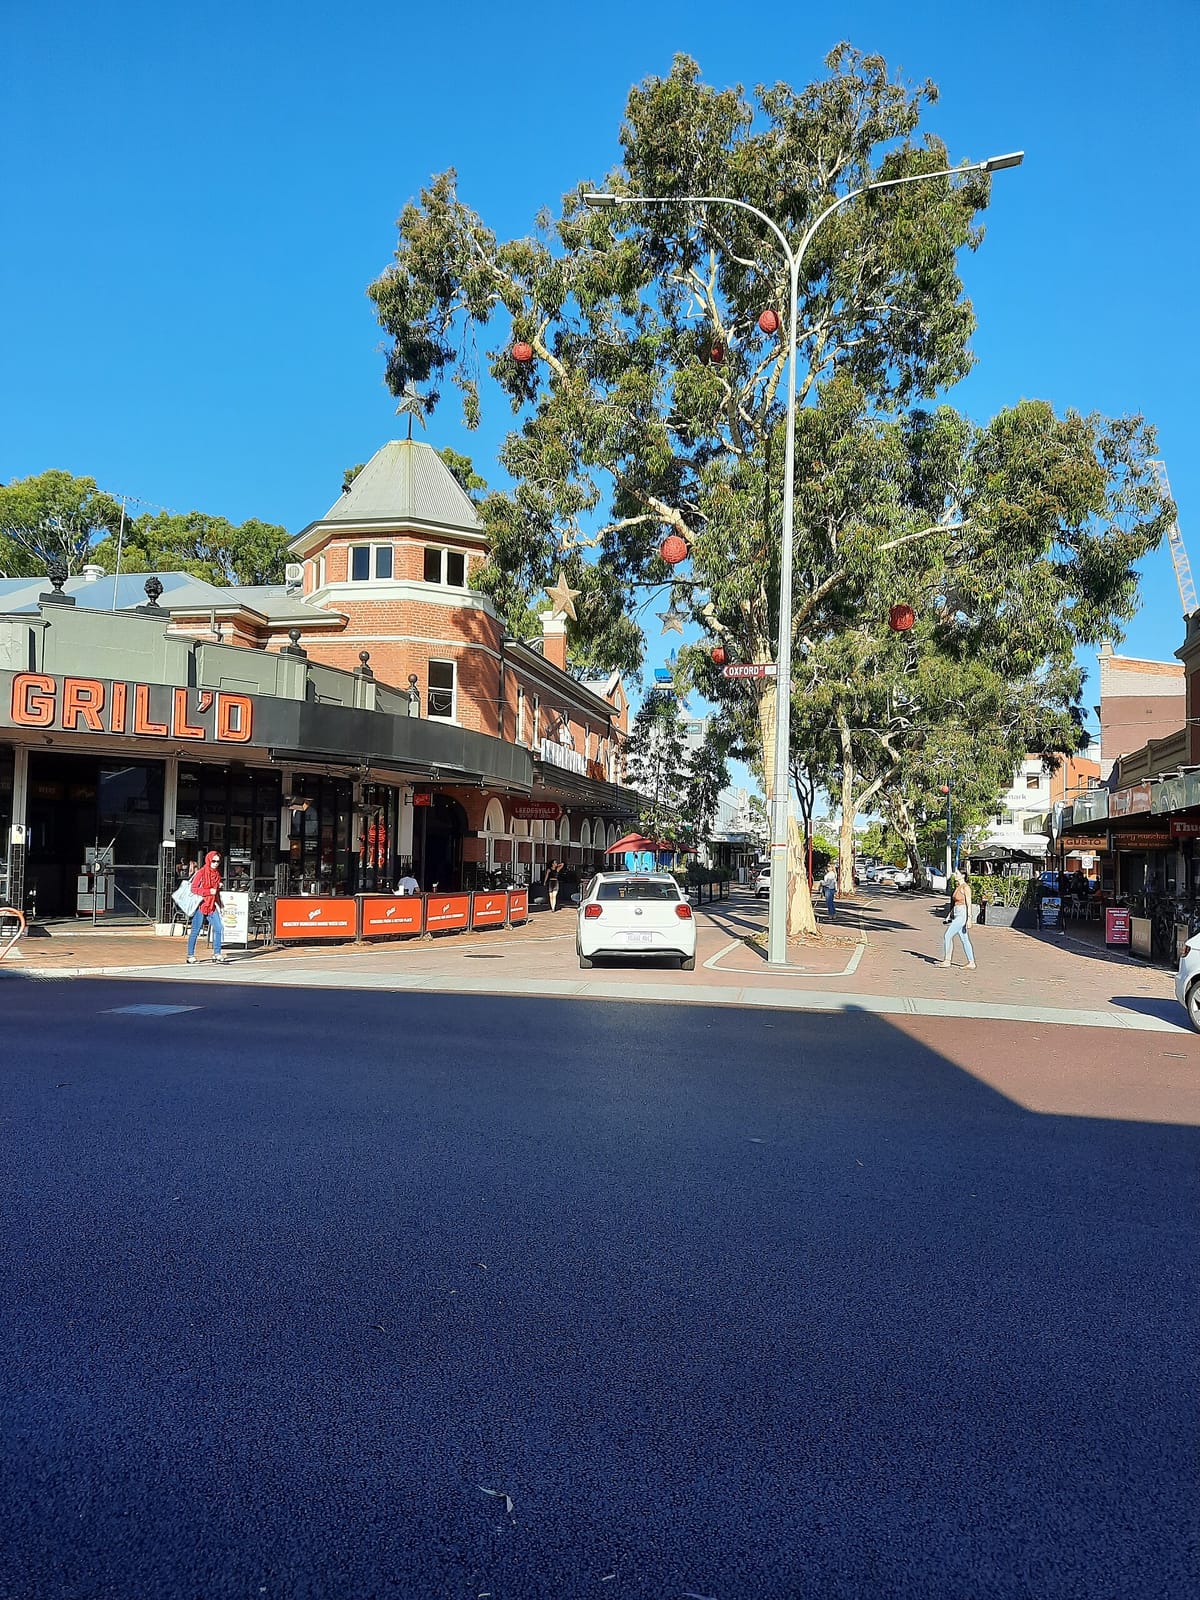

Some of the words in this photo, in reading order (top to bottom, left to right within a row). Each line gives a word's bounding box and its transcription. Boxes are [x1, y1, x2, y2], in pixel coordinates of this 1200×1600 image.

[729, 666, 759, 675] OXFORD
[11, 672, 252, 742] GRILL'D
[1173, 822, 1200, 832] Thu
[1066, 838, 1101, 846] GUSTO
